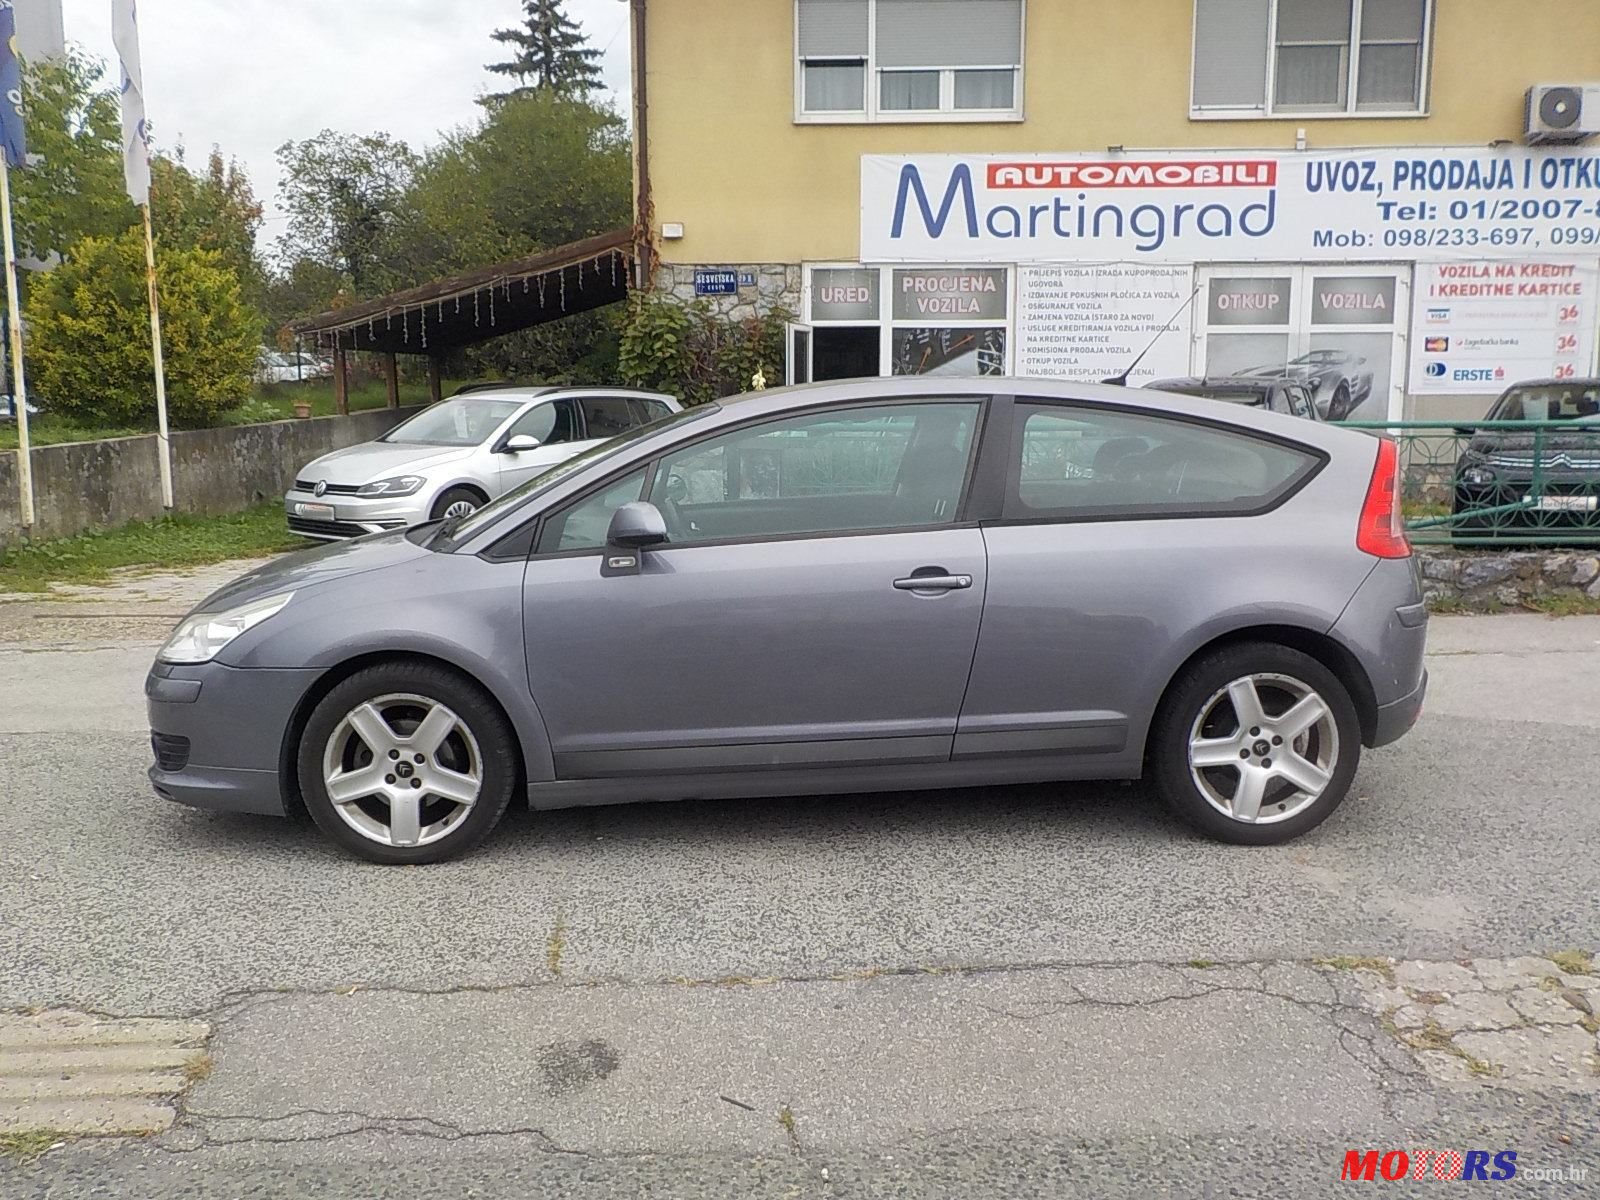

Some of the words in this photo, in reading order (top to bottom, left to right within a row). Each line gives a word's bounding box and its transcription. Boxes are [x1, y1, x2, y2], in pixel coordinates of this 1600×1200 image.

[995, 165, 1268, 186] AUTOMOBILI
[1306, 160, 1383, 198] UVOZ,
[1393, 159, 1514, 191] PRODAJA
[1523, 158, 1532, 189] I
[890, 163, 1276, 252] Martingrad
[1376, 201, 1437, 221] Tel:
[1313, 229, 1374, 248] Mob:
[1384, 227, 1540, 248] 098/233-697,
[696, 274, 735, 284] SESVETSKA
[1064, 269, 1090, 277] VOZILA
[1096, 269, 1123, 277] IZRADA
[1124, 269, 1188, 277] KUPOPRODAJNIH
[1438, 265, 1491, 278] VOZILA
[1494, 265, 1516, 278] NA
[1520, 264, 1576, 278] KREDIT
[902, 276, 997, 293] PROCJENA
[1028, 280, 1064, 288] UGOVORA
[1438, 283, 1514, 297] KREDITNE
[1518, 282, 1583, 296] KARTICE
[821, 287, 870, 304] URED
[1028, 291, 1069, 299] IZDAVANJE
[1070, 291, 1109, 299] POKUSNIH
[1143, 291, 1153, 299] ZA
[1154, 291, 1180, 299] VOZILA
[1217, 293, 1280, 311] OTKUP
[1319, 292, 1386, 310] VOZILA
[917, 297, 981, 314] VOZILA
[1559, 305, 1579, 321] 36
[1120, 313, 1130, 321] ZA
[1557, 334, 1577, 350] 36
[1068, 368, 1112, 376] BESPLATNA
[1453, 369, 1494, 381] ERSTE
[1555, 364, 1575, 380] 36
